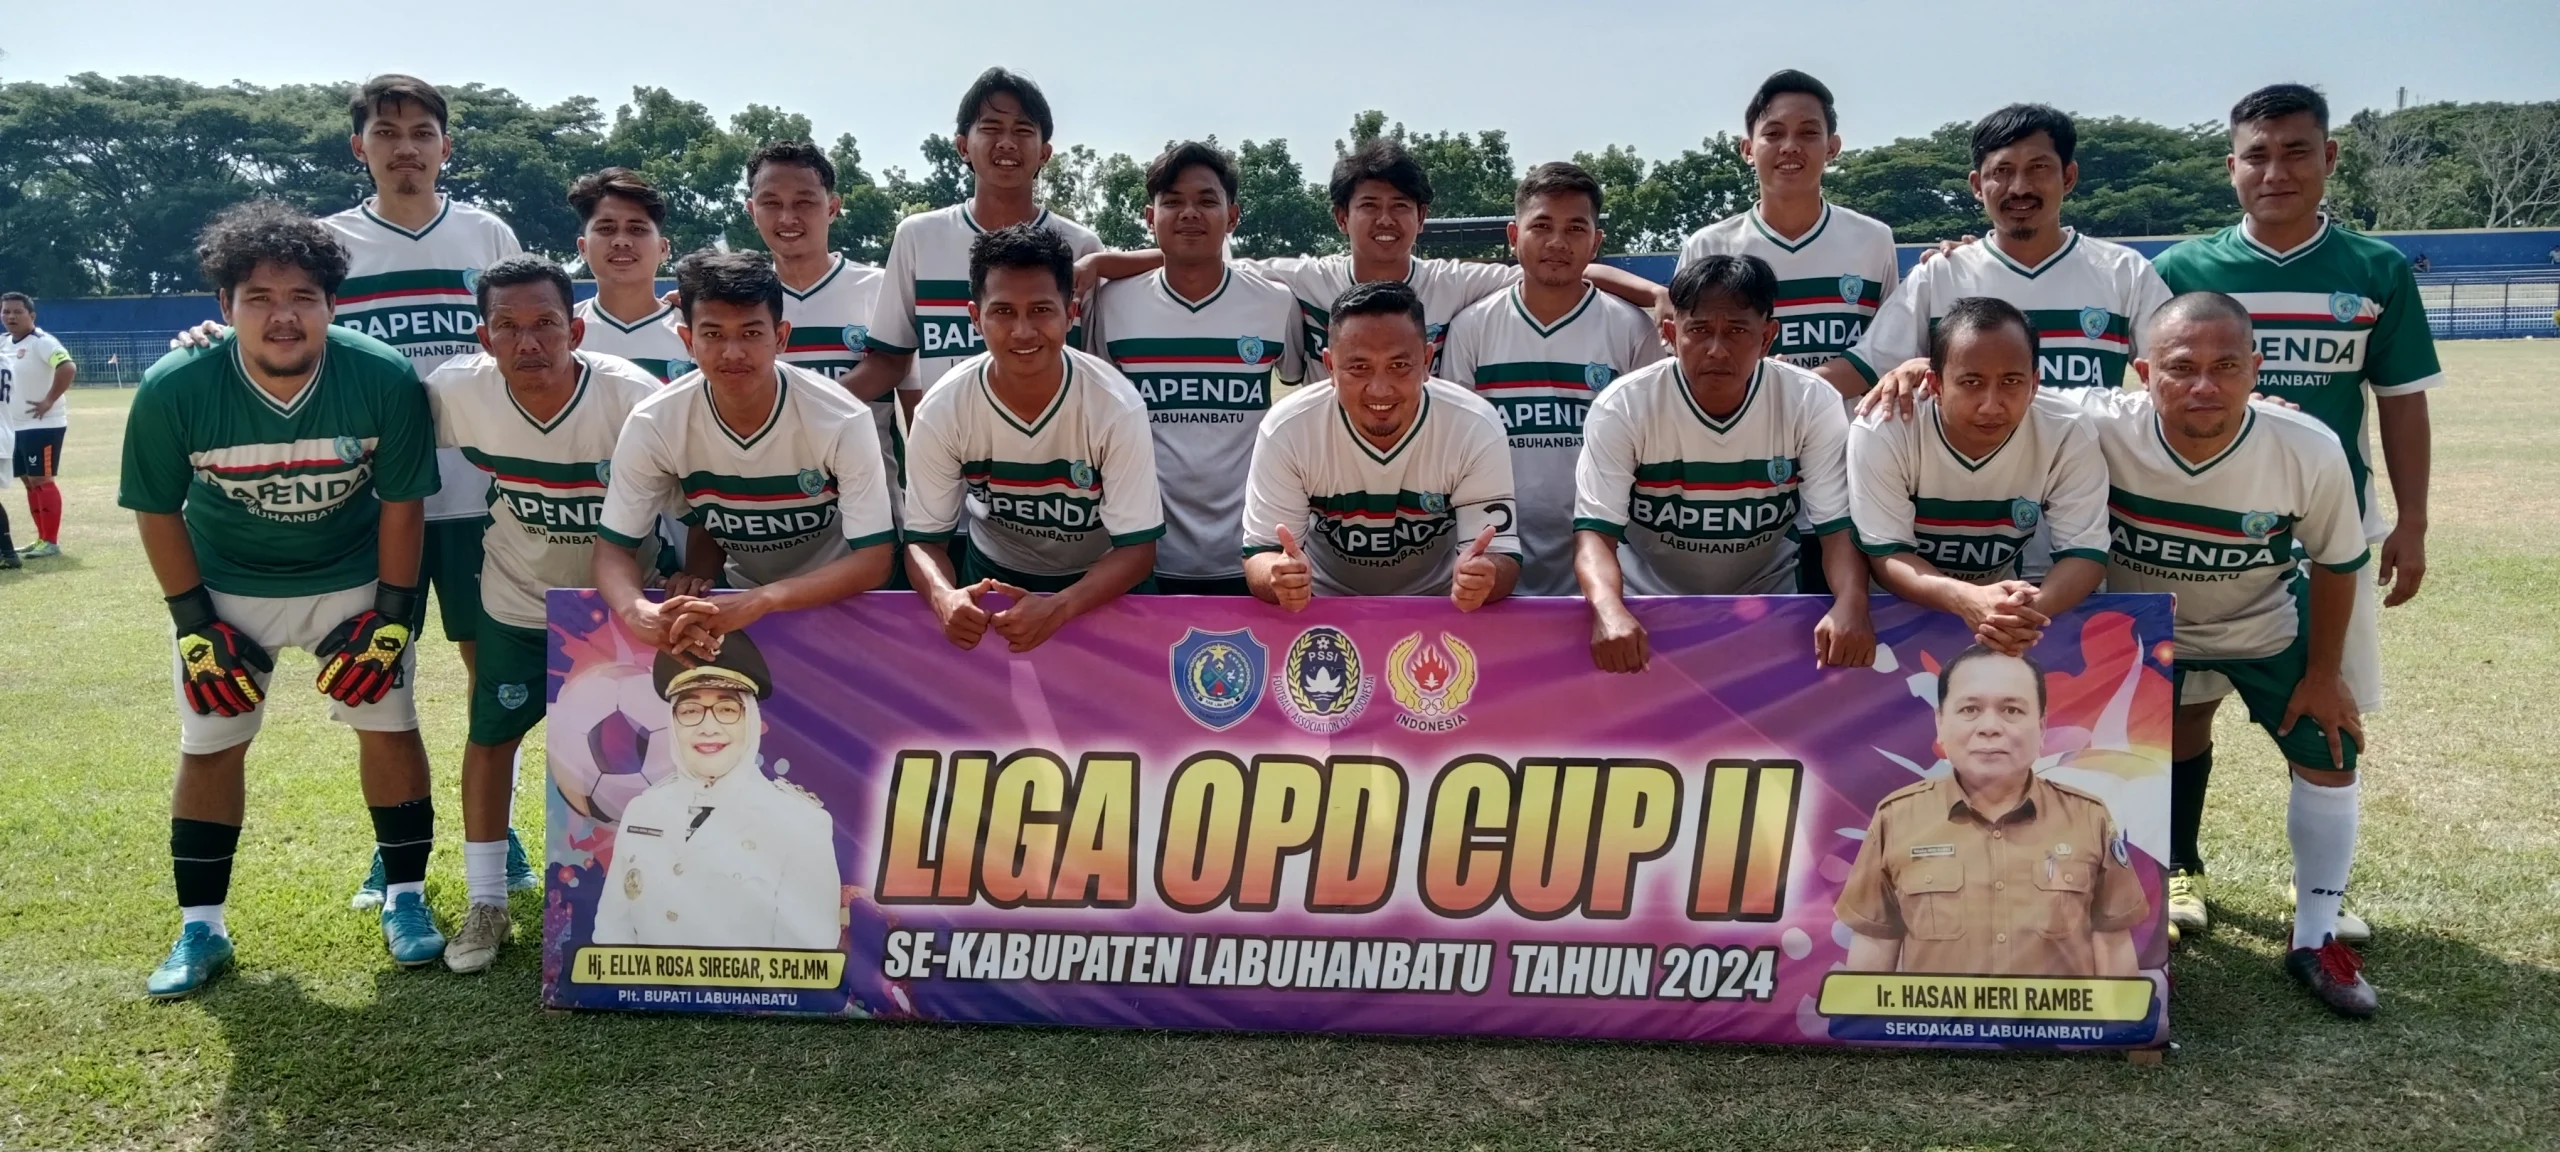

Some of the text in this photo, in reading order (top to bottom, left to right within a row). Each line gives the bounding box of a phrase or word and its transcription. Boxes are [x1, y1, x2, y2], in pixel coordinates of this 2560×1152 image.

[344, 311, 481, 339] APEND
[1782, 320, 1861, 346] ENDA
[399, 345, 475, 358] UHANBATU
[2253, 337, 2355, 364] ENDA
[1139, 378, 1264, 404] APENDA
[2256, 374, 2331, 387] HANBATU
[1497, 403, 1588, 428] APEND
[1508, 437, 1584, 449] ABUHANBAT
[502, 492, 603, 526] APEND
[704, 505, 838, 535] APENDA
[1633, 497, 1797, 531] BAPENDA
[721, 532, 821, 553] ABUHANBATU
[1332, 541, 1434, 568] LABUHANBATU
[1660, 533, 1773, 554] LABUHANBATU
[2110, 525, 2276, 567] APENDA
[2114, 554, 2240, 582] LABUHANBATU
[1308, 651, 1338, 662] PSSI
[1272, 675, 1374, 733] FOOTBALL ASSOCIATION OF INDONESIA
[1396, 713, 1467, 731] INDONESIA
[875, 749, 1803, 922] LIGA OPD CUP II
[588, 954, 829, 983] Hj. ELLYA ROSA SIREGAR, S.Pd.MM
[884, 930, 1777, 999] SE-KABUPATEN LABUHANBATU TAHUN 2024
[618, 990, 798, 1006] Plt. BUPATI LABUHANBATU
[1877, 984, 2094, 1012] Ir. HASAN HERI RAMBE
[1885, 1022, 2103, 1040] SEKDAKAB LABUHANBATU
